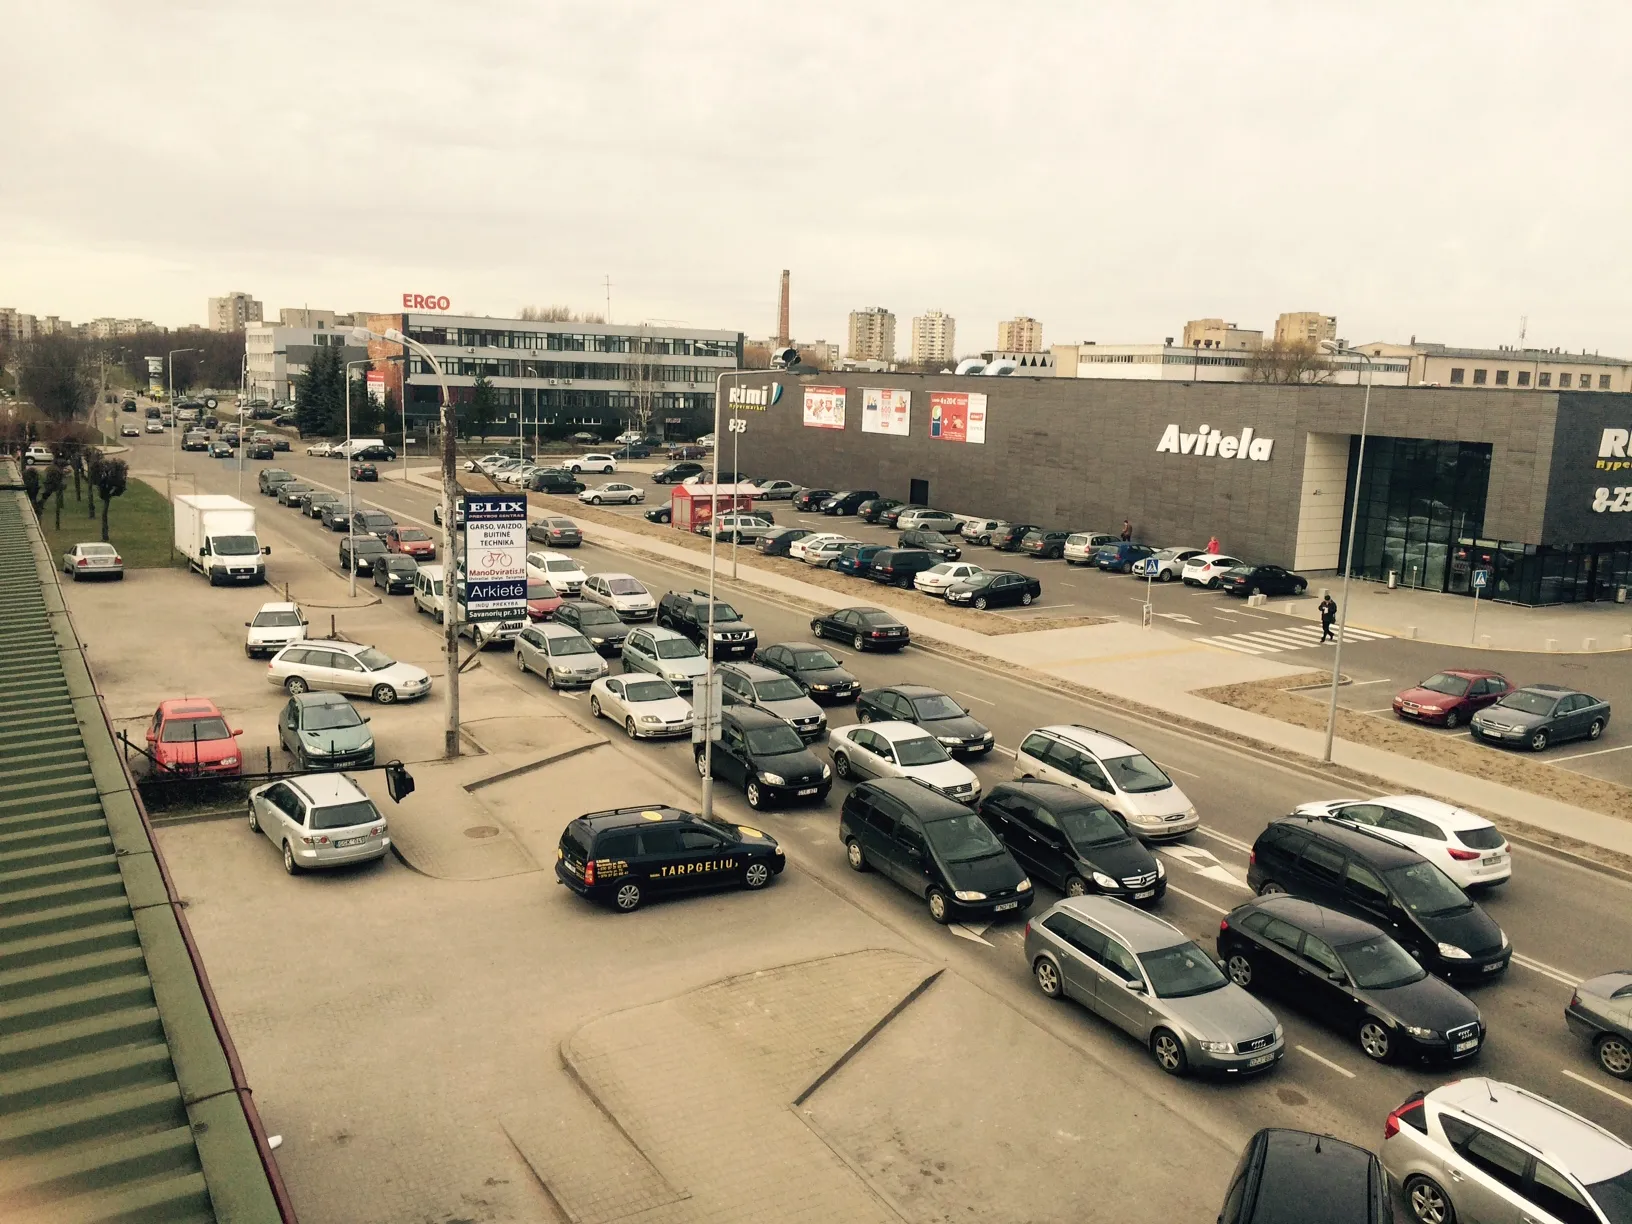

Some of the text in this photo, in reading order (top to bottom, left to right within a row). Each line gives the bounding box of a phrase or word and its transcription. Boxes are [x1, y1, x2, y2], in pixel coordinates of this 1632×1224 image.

[403, 294, 450, 310] ERGO
[729, 384, 769, 405] Rimi
[729, 418, 747, 433] 8-23
[1156, 424, 1275, 461] Avitela
[1595, 460, 1632, 471] Hype
[468, 503, 524, 512] ELIX
[471, 584, 524, 598] Arkietė
